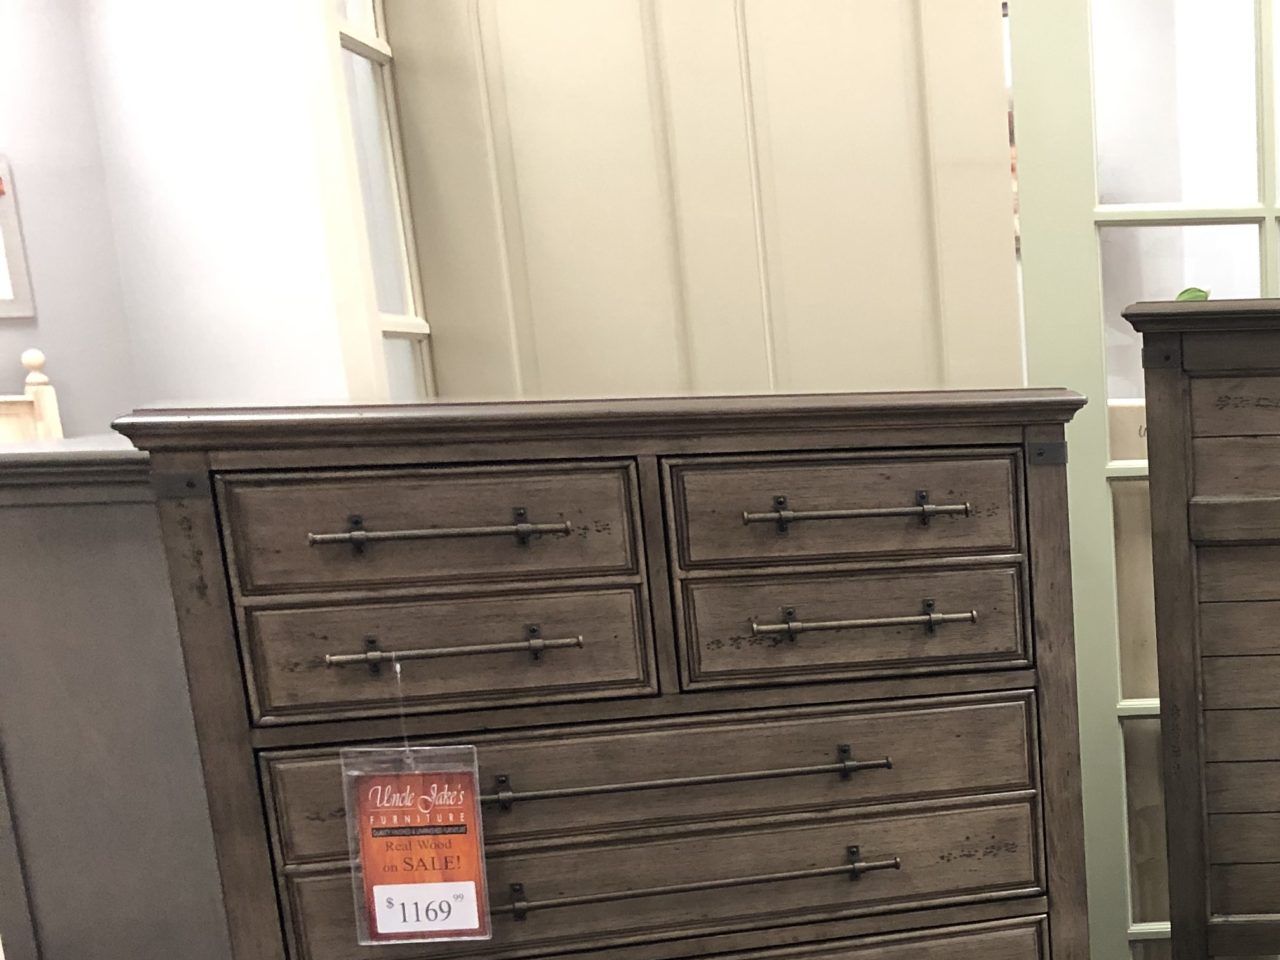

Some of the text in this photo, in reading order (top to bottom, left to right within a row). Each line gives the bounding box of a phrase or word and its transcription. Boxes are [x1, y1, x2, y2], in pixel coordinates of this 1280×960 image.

[368, 783, 465, 813] Uncle Jake's
[369, 812, 465, 825] FURNITURE
[385, 838, 453, 852] Real Wood
[383, 856, 461, 872] on SALE!
